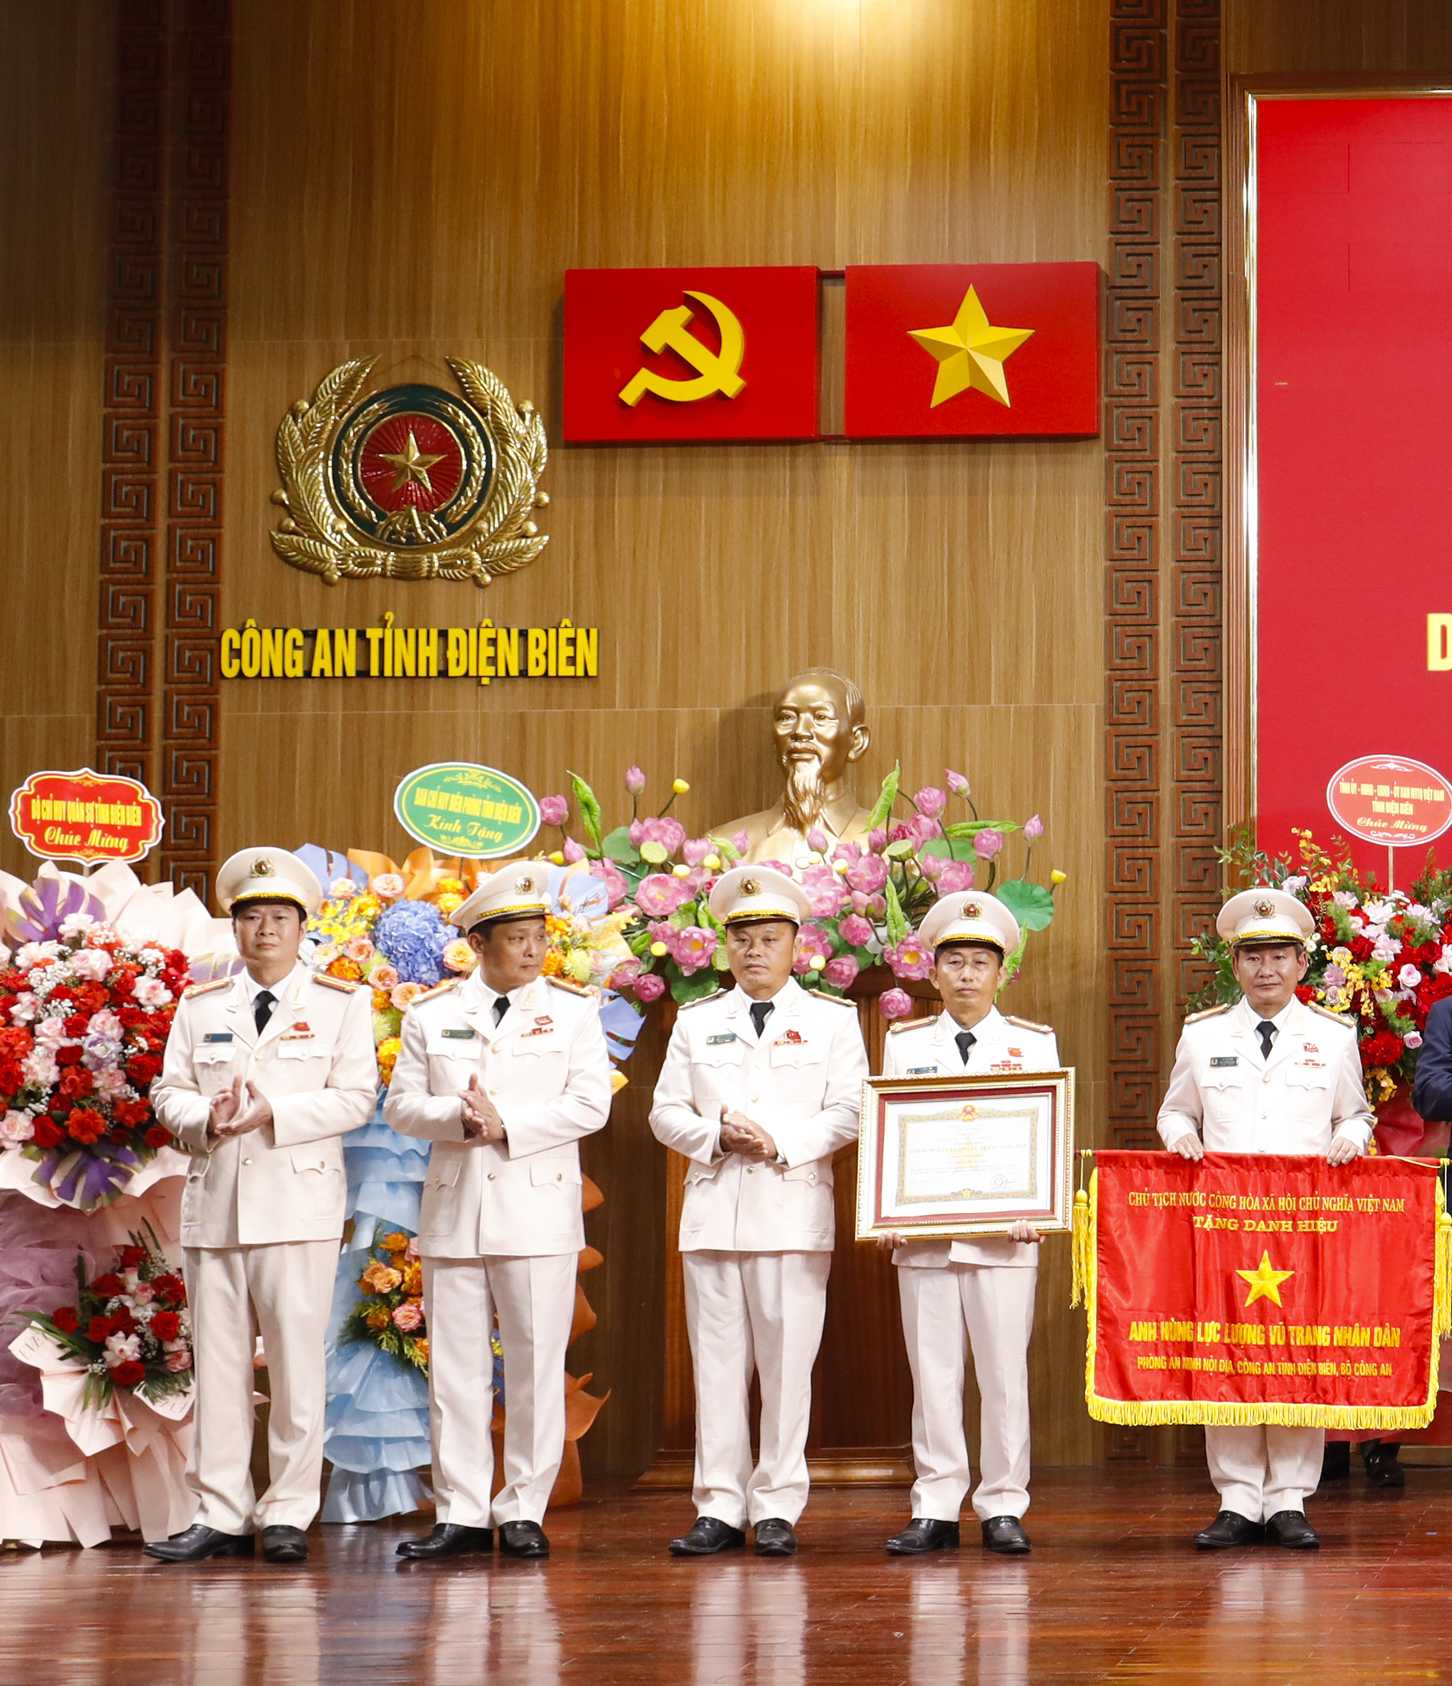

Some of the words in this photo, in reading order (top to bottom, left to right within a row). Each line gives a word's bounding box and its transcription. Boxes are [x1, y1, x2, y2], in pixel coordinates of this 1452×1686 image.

[221, 618, 304, 678] CÔNG
[311, 628, 356, 677] AN
[366, 611, 438, 677] TỈNH
[446, 618, 519, 685] ĐIỆN
[527, 618, 598, 677] BIÊN
[1357, 817, 1388, 828] Chúc
[44, 826, 81, 846] Chúc
[84, 829, 128, 853] Mừng
[1128, 1187, 1150, 1206] CHỦ
[1152, 1192, 1176, 1210] TỊCH
[1240, 1192, 1260, 1210] HÒA
[1278, 1192, 1296, 1214] HỘI
[1299, 1191, 1320, 1211] CHỦ
[1356, 1194, 1380, 1215] VIỆT
[1382, 1198, 1405, 1212] NAM
[1244, 1219, 1293, 1232] DANH
[1297, 1217, 1339, 1234] HIỆU
[1129, 1321, 1157, 1341] ANH
[1288, 1326, 1331, 1346] TRANG
[1333, 1322, 1371, 1346] NHÂN
[1169, 1357, 1180, 1369] AN
[1264, 1363, 1275, 1375] AN
[1380, 1363, 1392, 1376] AN
